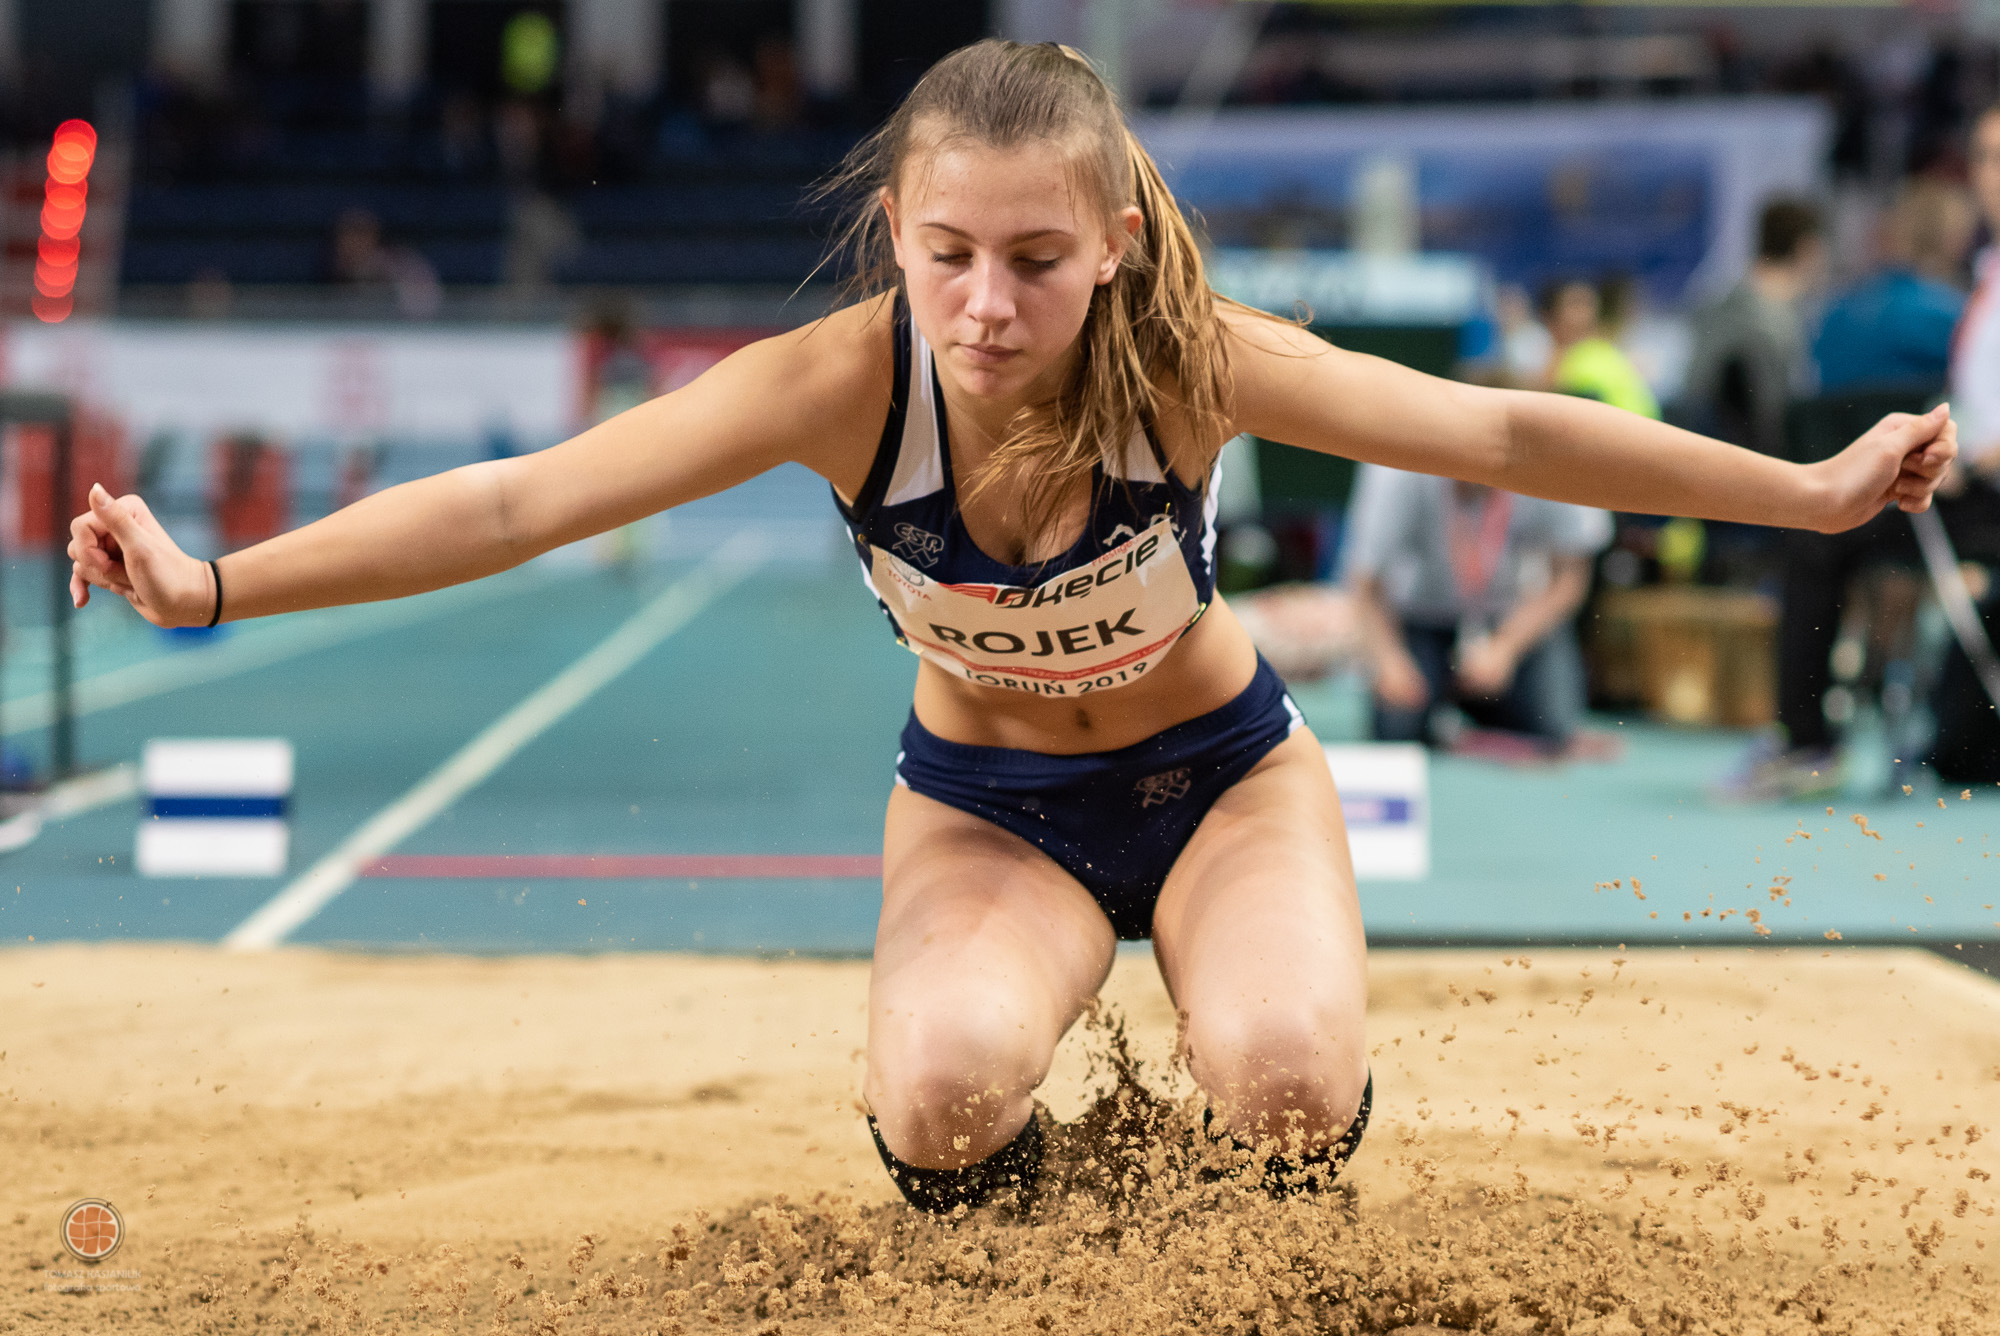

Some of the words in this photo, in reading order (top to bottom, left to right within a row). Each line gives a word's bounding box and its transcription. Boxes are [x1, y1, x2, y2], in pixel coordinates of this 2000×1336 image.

[887, 568, 932, 601] TOYOTA
[928, 607, 1145, 656] ROJEK
[1077, 662, 1148, 694] 2019
